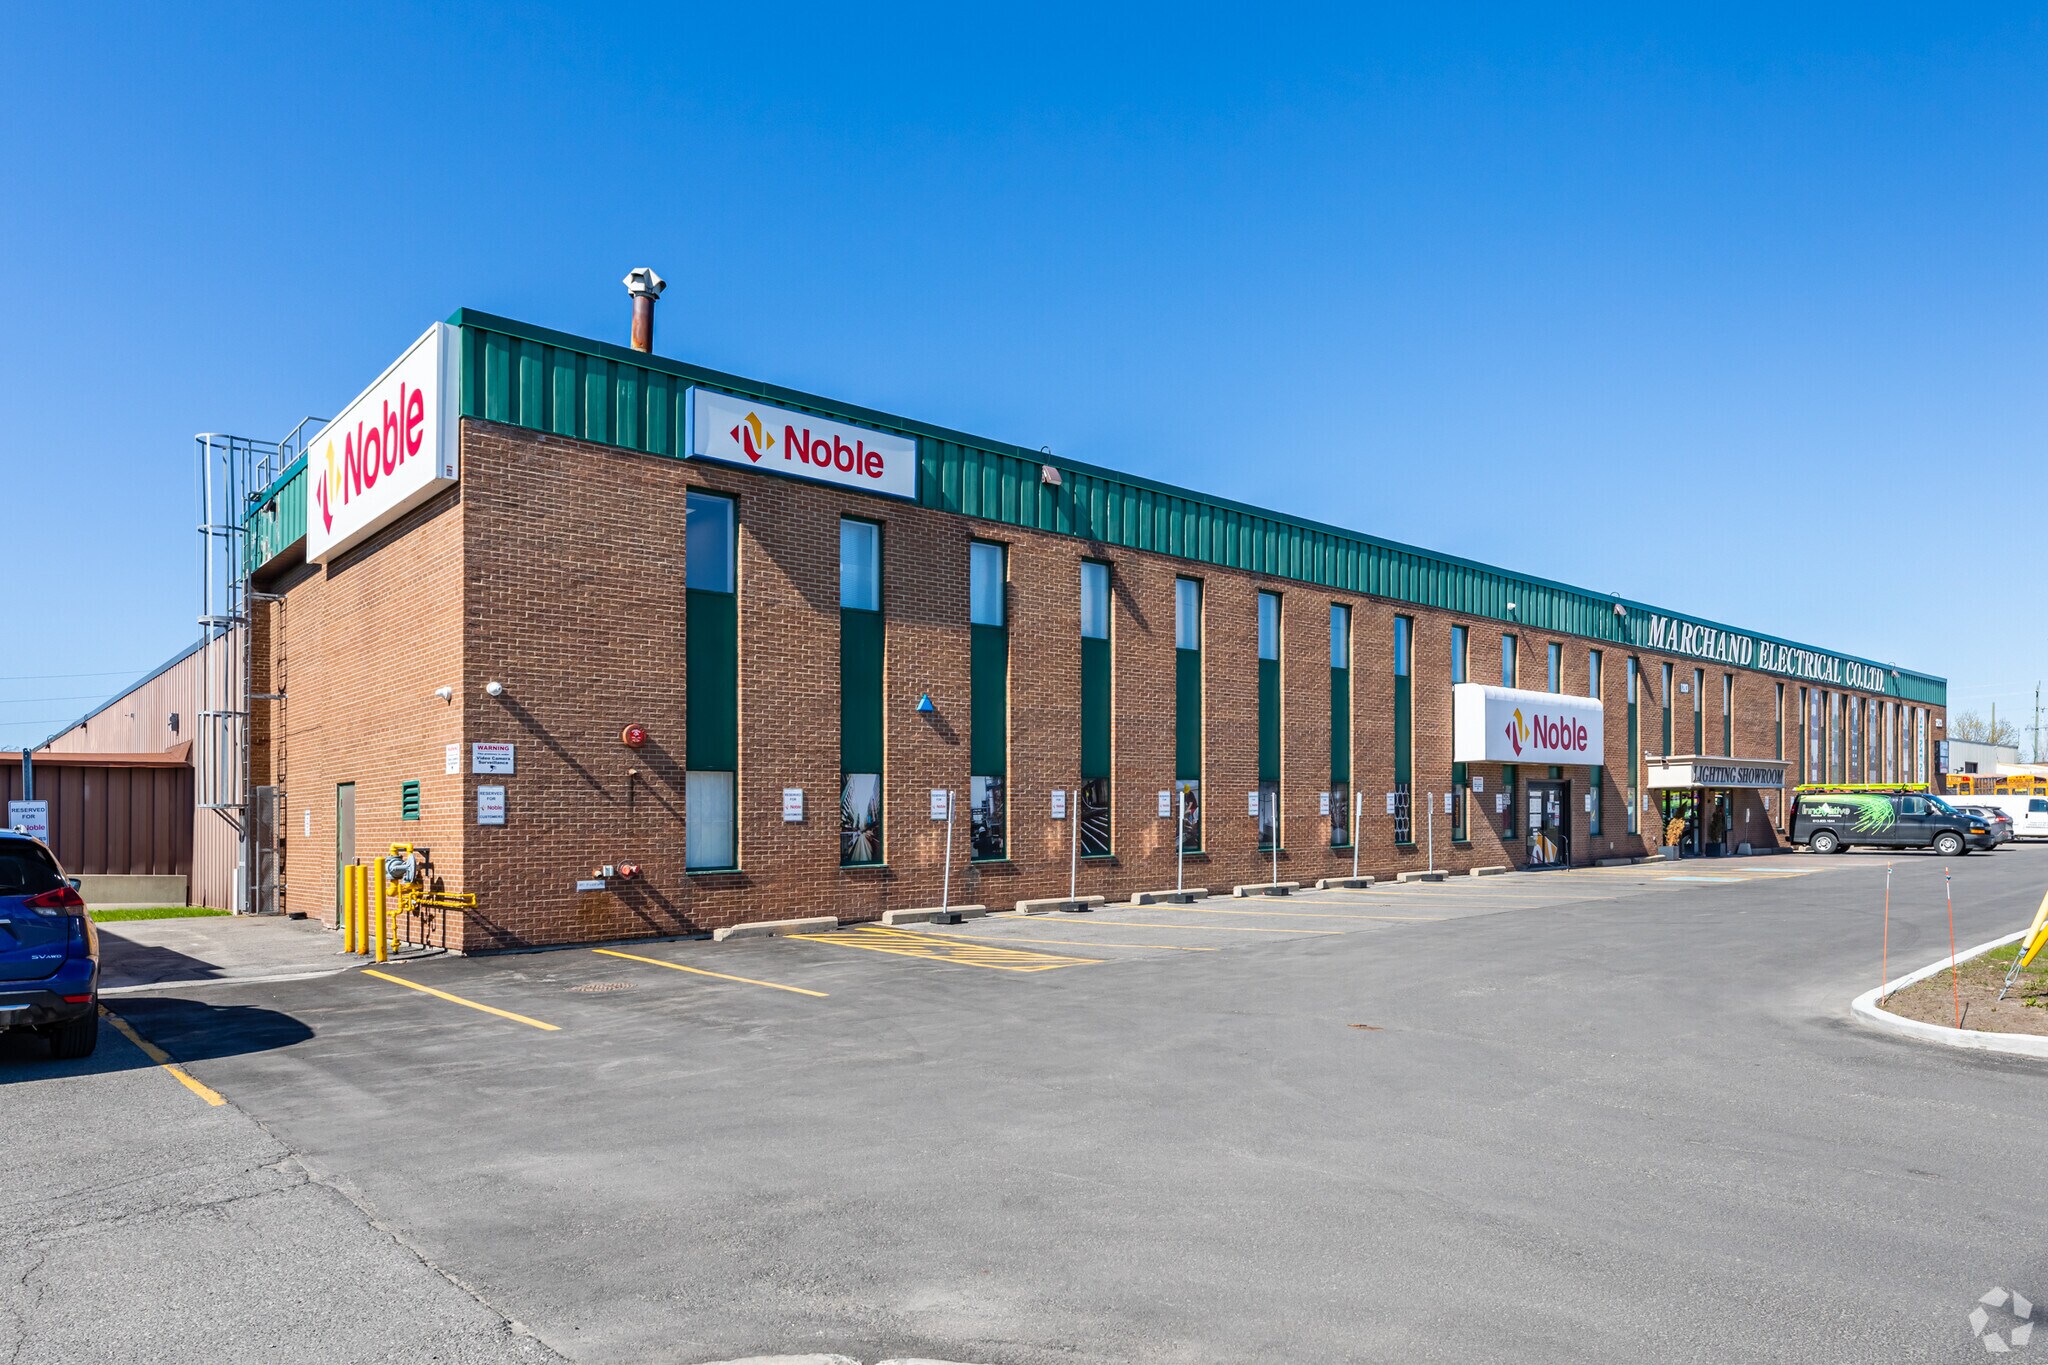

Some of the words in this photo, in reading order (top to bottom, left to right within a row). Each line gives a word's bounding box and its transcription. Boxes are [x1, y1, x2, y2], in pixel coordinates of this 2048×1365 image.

[343, 381, 424, 505] Noble
[784, 425, 884, 478] Noble
[1647, 614, 1753, 665] MARCHAND
[1758, 640, 1841, 683] ELECTRICAL
[1534, 714, 1587, 751] Noble
[1693, 765, 1736, 783] LIGHTING
[1737, 768, 1784, 784] SHOWROOM
